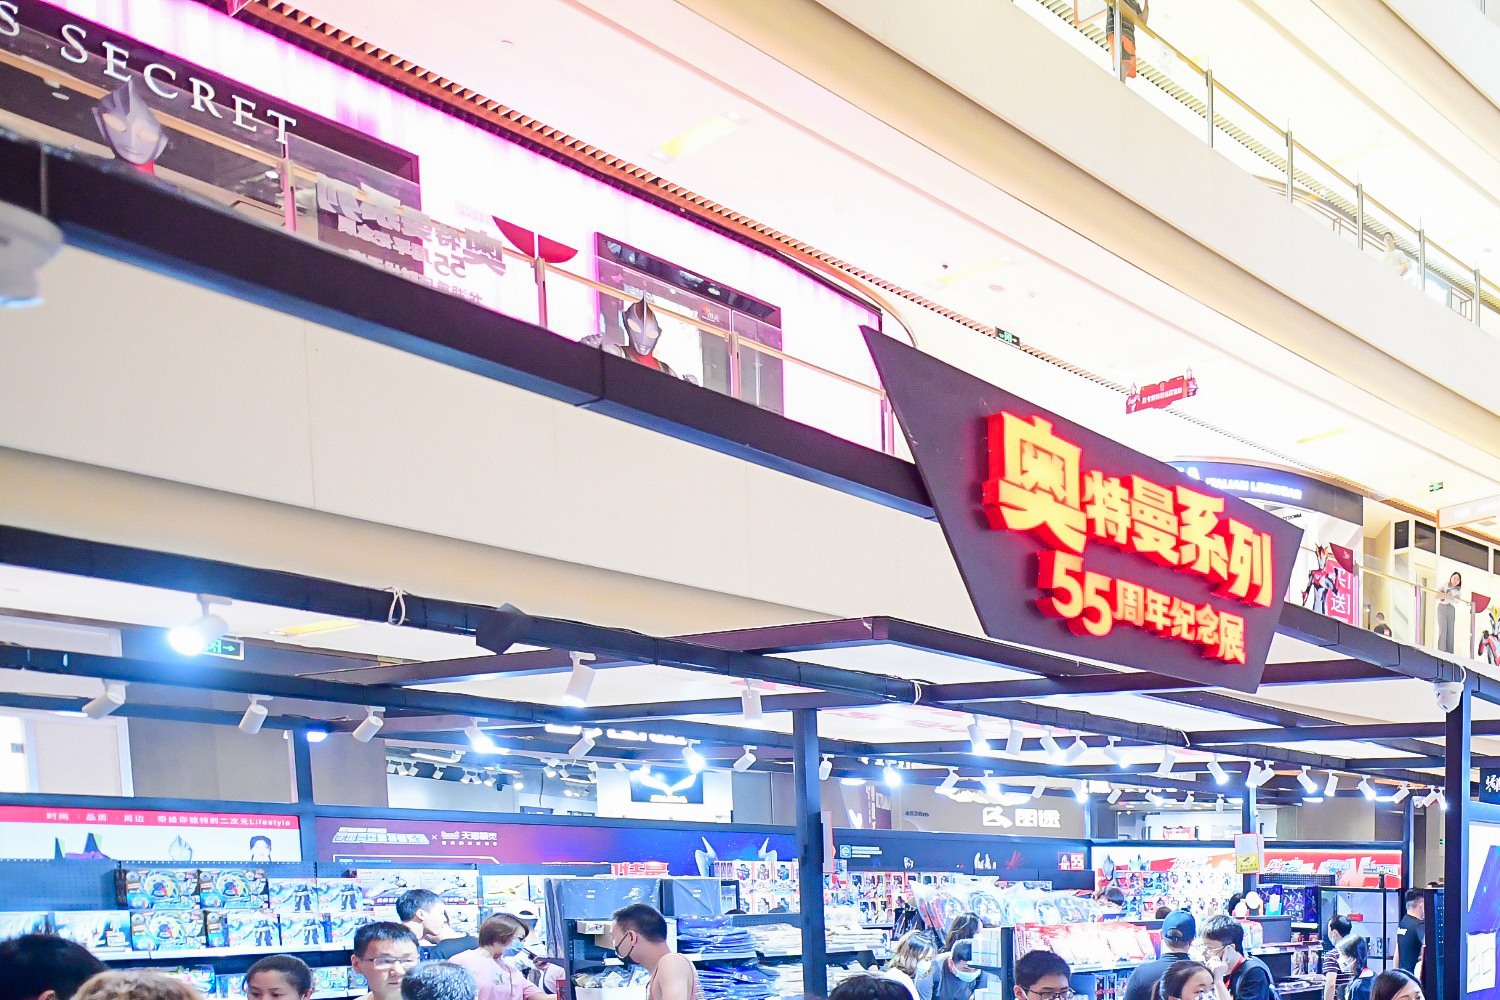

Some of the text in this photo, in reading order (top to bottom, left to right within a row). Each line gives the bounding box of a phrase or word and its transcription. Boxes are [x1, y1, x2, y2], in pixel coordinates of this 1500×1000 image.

[60, 23, 297, 145] SECRET
[990, 410, 1273, 609] 奥特曼系列
[1046, 550, 1247, 664] 55周年纪念展
